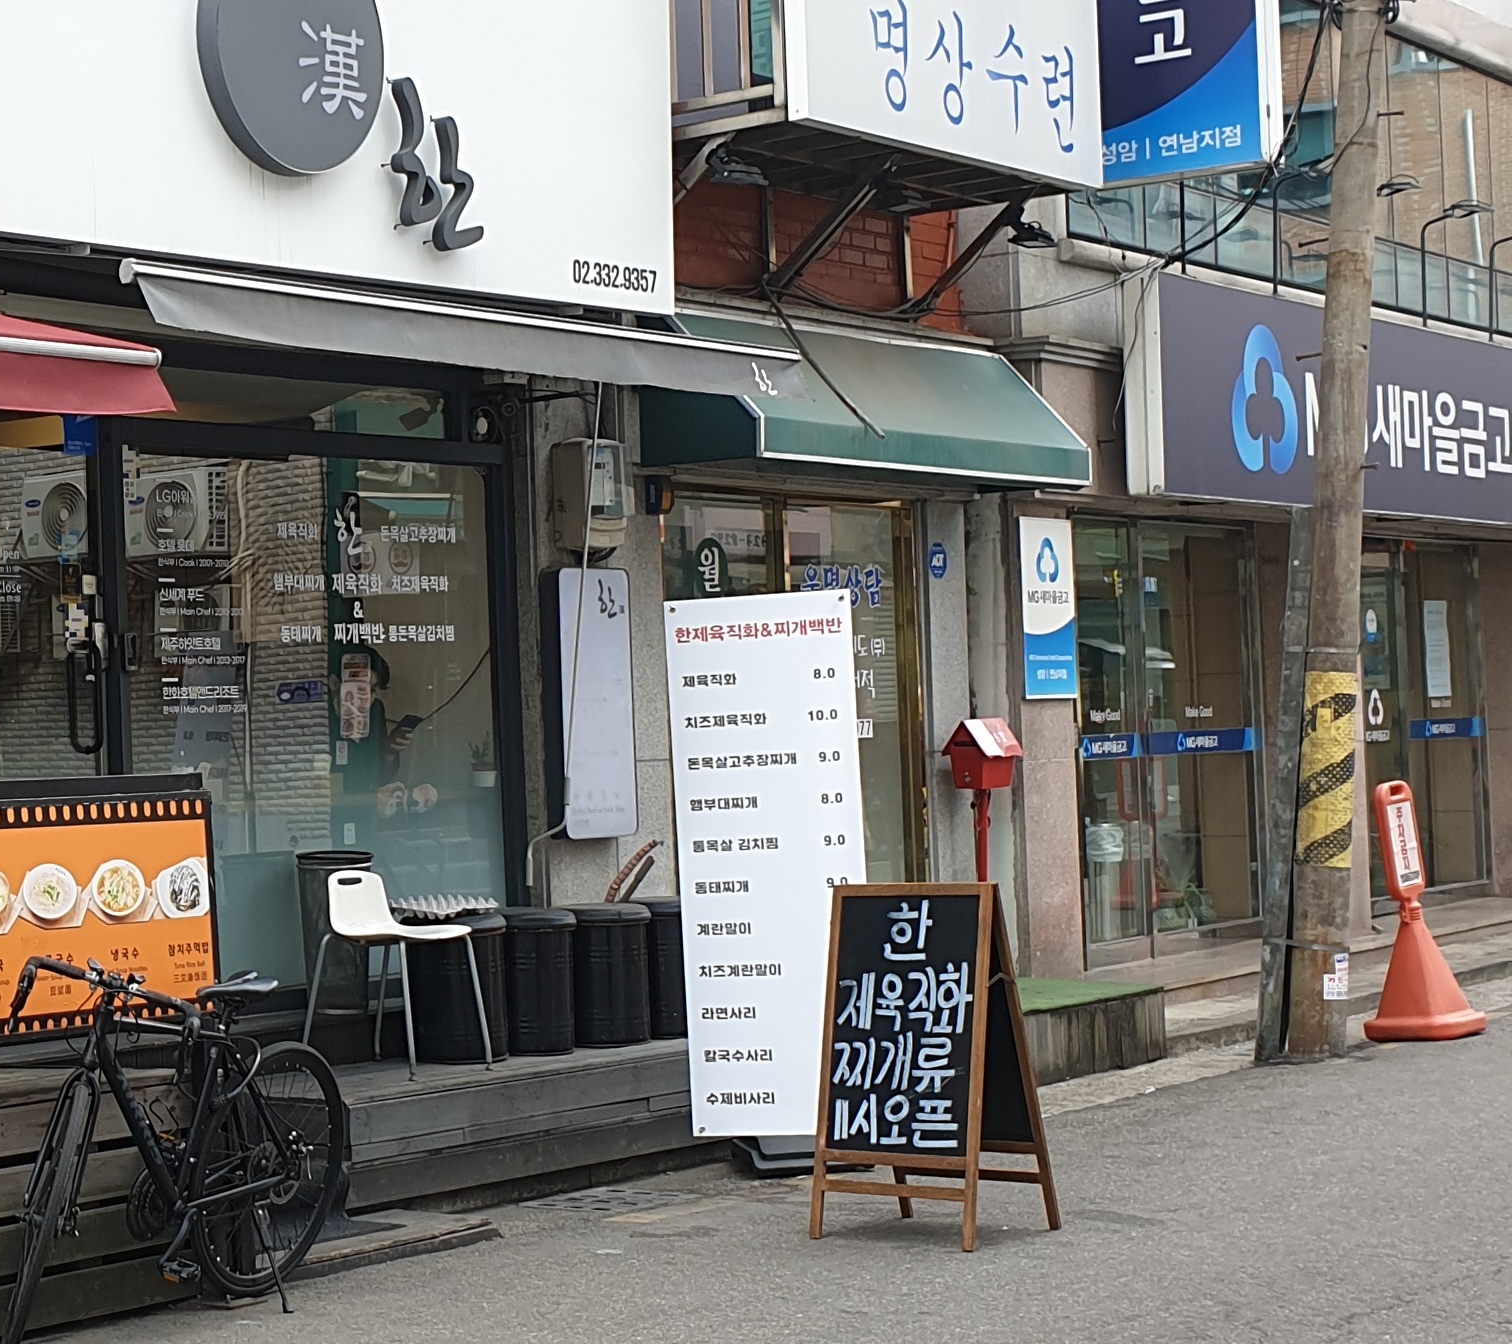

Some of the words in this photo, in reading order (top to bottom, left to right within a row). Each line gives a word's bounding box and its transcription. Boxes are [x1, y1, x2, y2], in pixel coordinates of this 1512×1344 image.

[297, 19, 370, 121] 漢
[1158, 124, 1242, 157] 연남지점
[571, 258, 658, 296] 02.332.9357
[1305, 372, 1512, 479] 새마을금고
[276, 523, 319, 540] 제육직화
[331, 572, 383, 595] 제육직화
[391, 574, 450, 593] 치즈제육직화
[353, 600, 365, 619] &
[280, 625, 323, 643] 동태찌개
[333, 622, 387, 645] 찌개백반
[674, 617, 844, 644] 한제육직화&찌개백반
[681, 672, 738, 688] 제육직화
[812, 667, 836, 680] 8.0
[684, 712, 767, 730] 치즈제육직화
[807, 708, 839, 722] 10.0
[858, 720, 872, 737] 77
[687, 752, 798, 771] 돈목살고추장찌개
[818, 750, 841, 763] 9.0
[689, 795, 759, 812] 햄부대찌개
[820, 792, 844, 805] 8.0
[737, 836, 780, 852] 김치찜
[823, 834, 846, 847] 9.0
[694, 880, 750, 895] 동태찌개
[696, 921, 752, 937] 계란말이
[882, 898, 933, 962] 한
[110, 946, 140, 962] 냉국수
[167, 941, 210, 957] 참치주먹밥
[698, 963, 783, 979] 치즈계란말이
[835, 961, 975, 1036] 제육직화
[701, 1006, 757, 1021] 라면사리
[703, 1048, 773, 1064] 칼국수사리
[832, 1030, 957, 1095] 찌개류
[705, 1091, 776, 1106] 수제비사리
